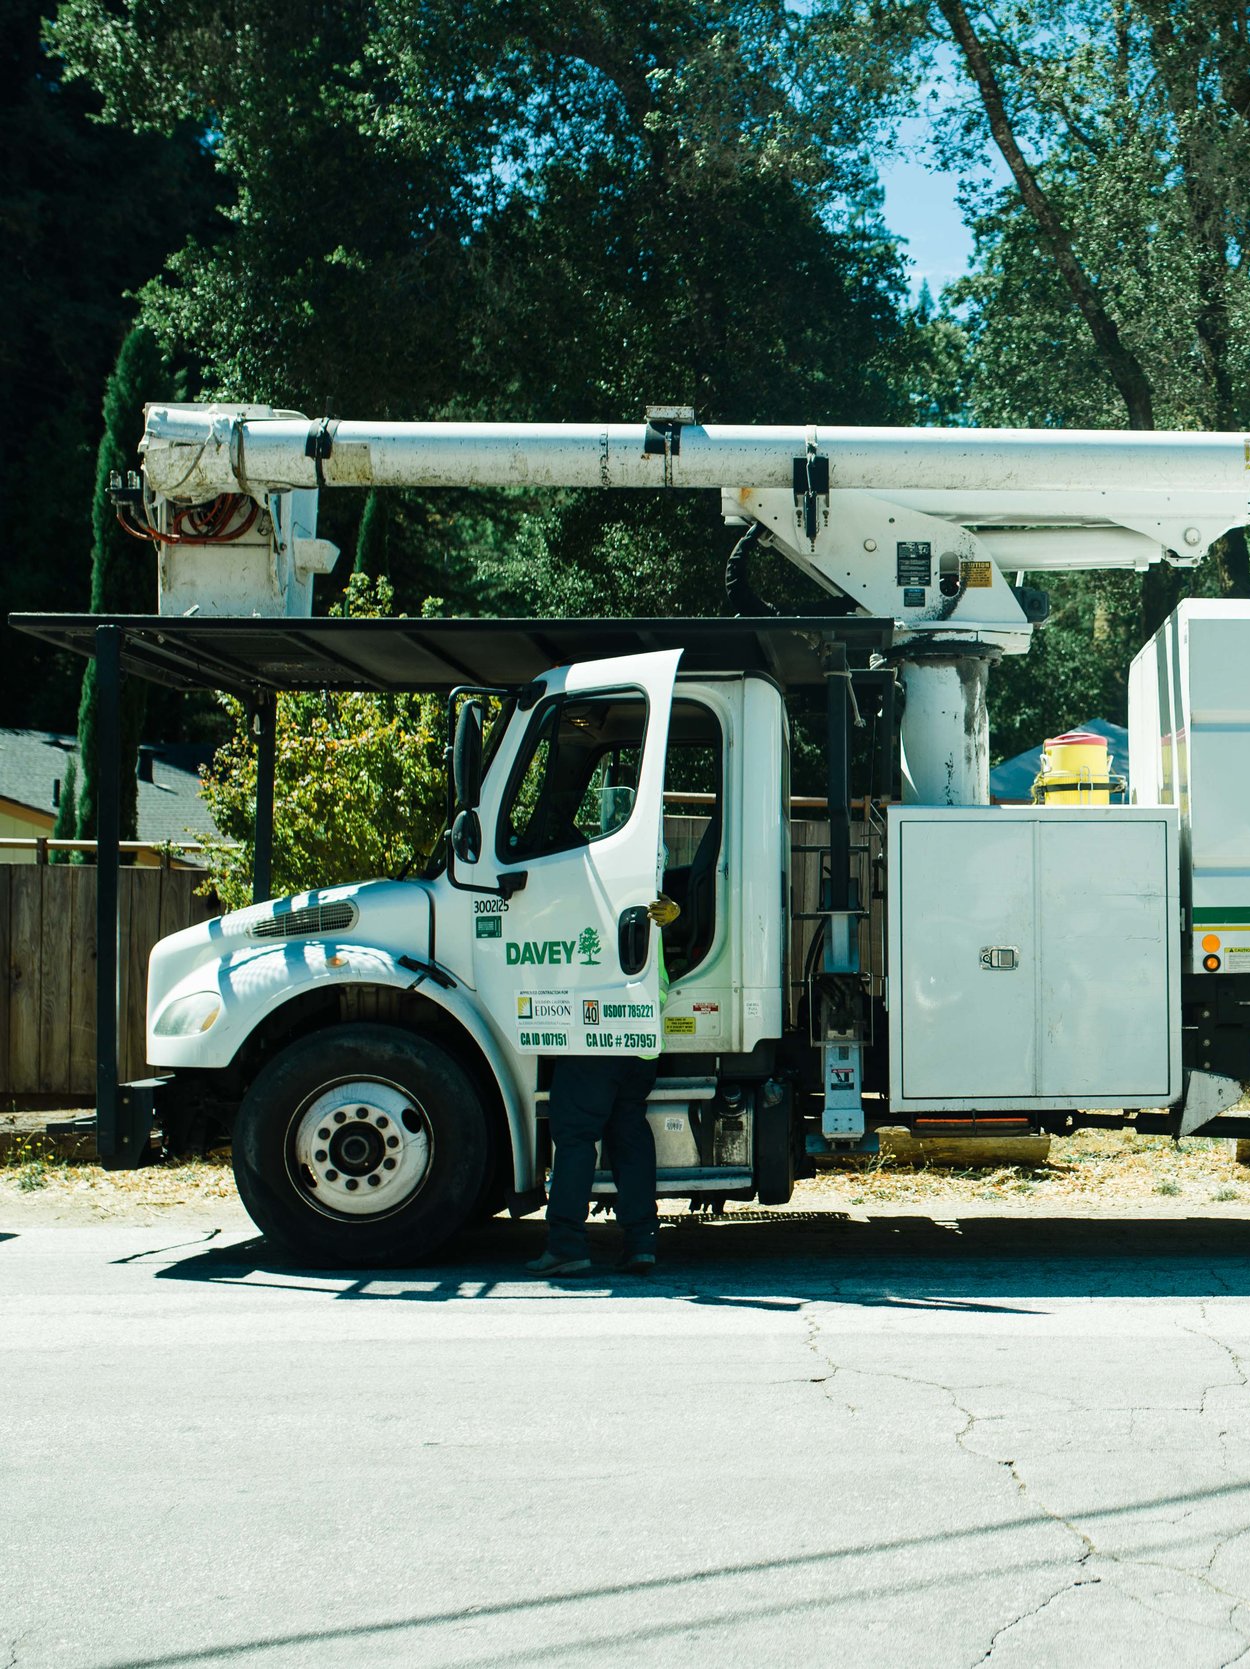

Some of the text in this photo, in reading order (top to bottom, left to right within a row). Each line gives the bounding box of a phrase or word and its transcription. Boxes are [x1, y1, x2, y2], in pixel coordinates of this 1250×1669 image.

[474, 899, 509, 913] 3002125
[505, 940, 577, 965] DAVEY
[535, 1005, 571, 1016] EDISON
[585, 1006, 597, 1022] 40
[603, 1004, 653, 1018] USDOT 785221
[520, 1033, 567, 1046] CA ID 107151
[586, 1033, 657, 1048] CA LIC # 257957
